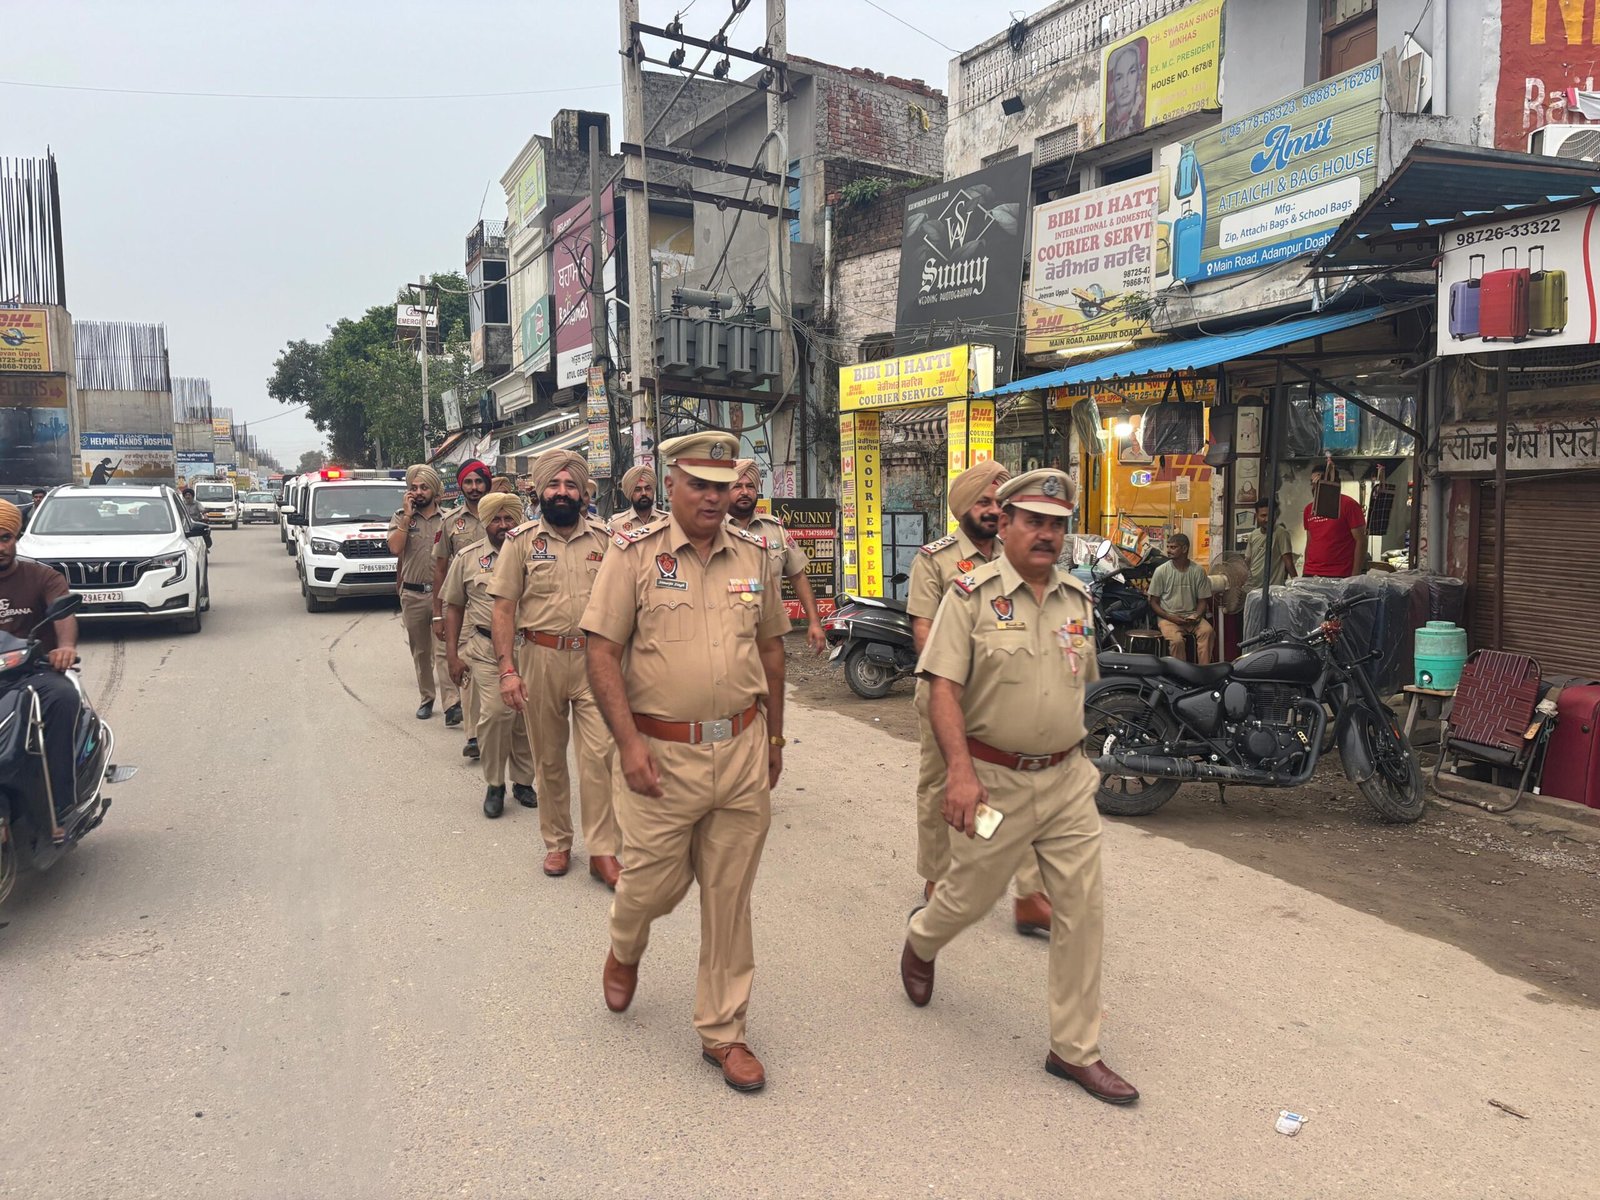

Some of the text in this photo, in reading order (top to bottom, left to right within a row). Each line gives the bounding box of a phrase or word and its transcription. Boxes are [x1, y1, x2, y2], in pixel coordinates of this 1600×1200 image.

[1163, 20, 1194, 39] SWARAN
[1195, 6, 1220, 24] SINGH
[1169, 30, 1197, 49] MINHAS
[1176, 40, 1216, 63] PRESIDENT
[1151, 59, 1213, 91] HOUSE NO. 1678/8
[1301, 65, 1380, 108] 98883-16280
[1250, 116, 1334, 175] Amit
[1218, 146, 1375, 213] ATTAICHI & BAG HOUSE
[1048, 207, 1081, 231] BIBI
[1084, 202, 1102, 222] DI
[1055, 221, 1109, 241] INTERNATIONAL
[1109, 219, 1115, 228] &
[1224, 198, 1354, 244] Zip, Attachi Bags & School Bags
[1455, 218, 1562, 247] 98726-33322
[1037, 234, 1100, 263] COURIER
[1213, 257, 1234, 273] Main
[1235, 251, 1260, 268] Road,
[1260, 239, 1304, 264] Adampur
[919, 255, 989, 295] Sunny
[397, 317, 435, 326] EMERGCY
[1049, 337, 1065, 348] MAIN
[1065, 335, 1084, 346] ROAD,
[1085, 331, 1118, 343] ADAMPUR
[566, 370, 576, 380] ATUL
[853, 351, 951, 382] BIBI DI HATTI
[858, 386, 945, 406] COURIER SERVICE
[857, 419, 878, 431] DHL
[971, 408, 993, 421] DHL
[90, 437, 173, 447] HELPING HANDS HOSPITAL
[864, 454, 875, 538] COURIER
[793, 511, 832, 524] SUNNY
